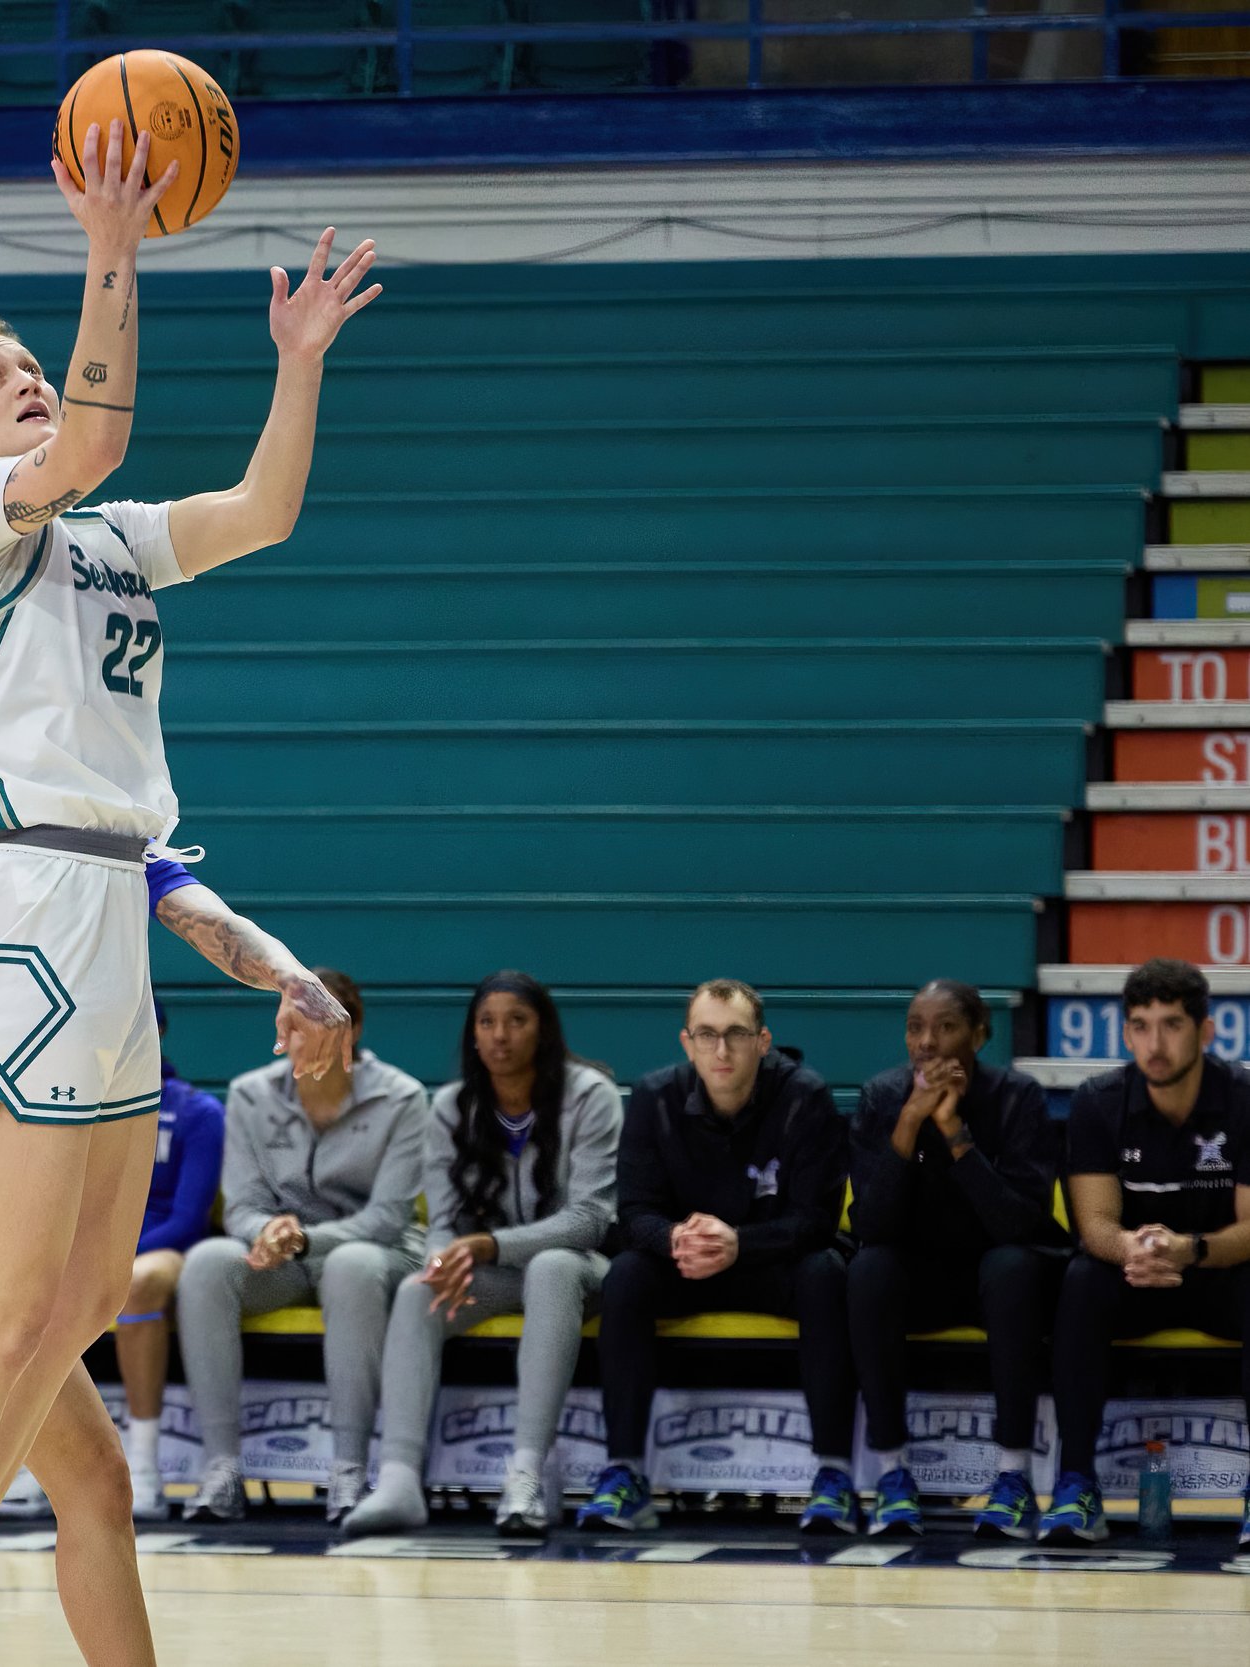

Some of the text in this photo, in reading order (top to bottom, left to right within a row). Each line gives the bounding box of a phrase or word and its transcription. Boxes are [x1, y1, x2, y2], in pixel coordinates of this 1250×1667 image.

[102, 612, 161, 698] 22
[1159, 653, 1228, 703] TO
[1214, 1002, 1250, 1061] 9
[654, 1406, 814, 1447] CAPITA
